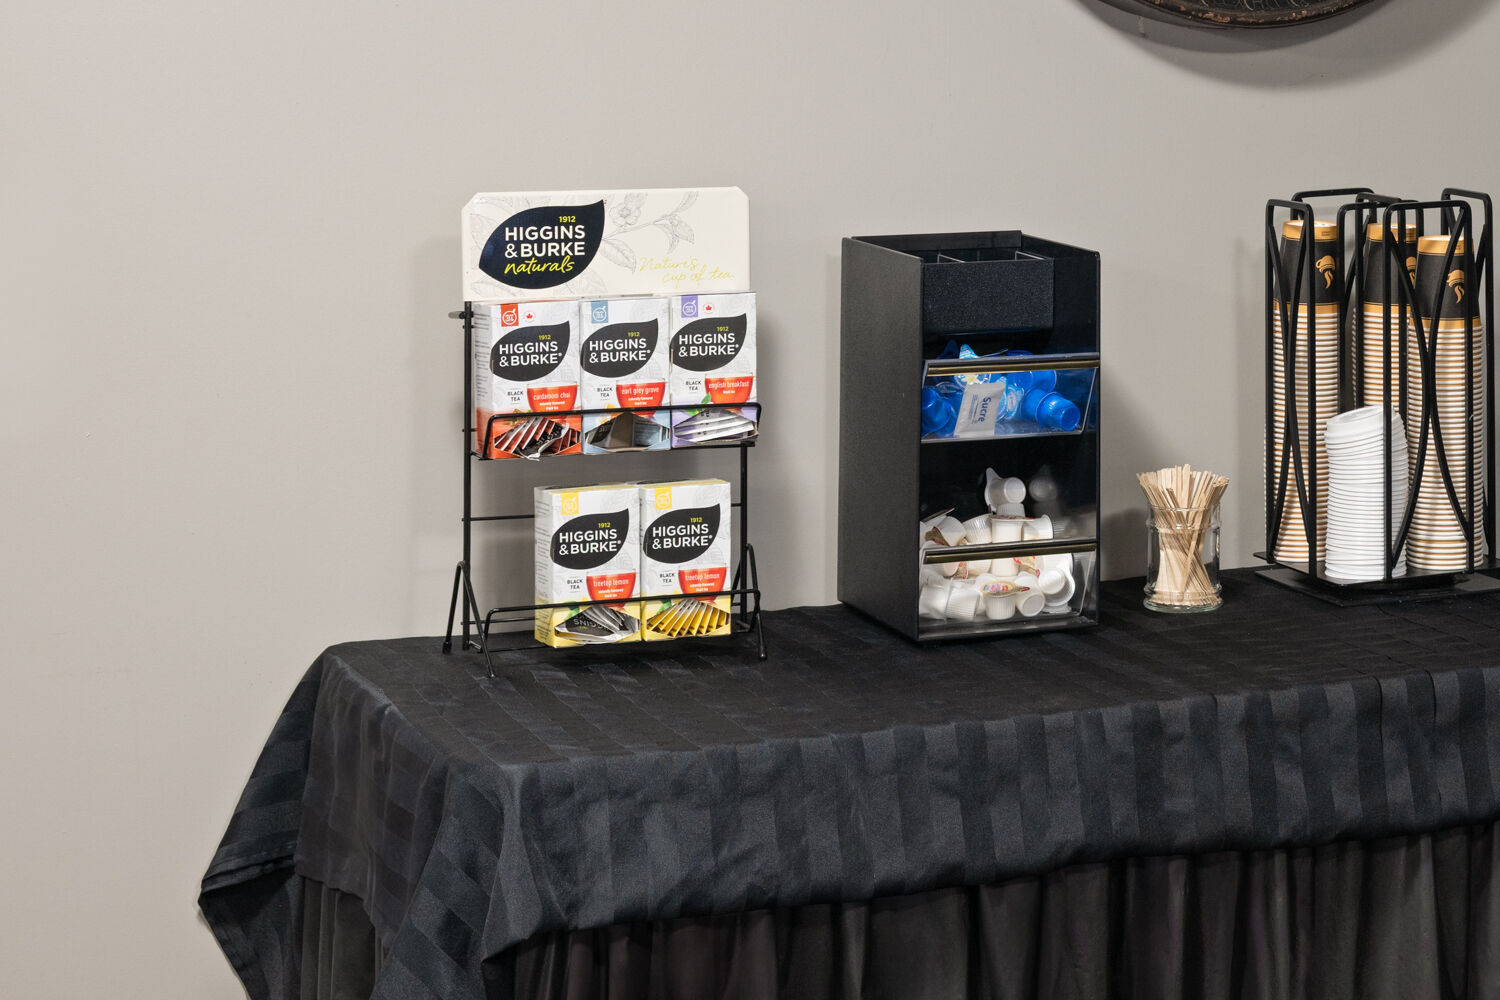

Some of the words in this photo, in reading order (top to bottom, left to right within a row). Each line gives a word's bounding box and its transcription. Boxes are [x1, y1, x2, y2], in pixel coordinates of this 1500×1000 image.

[505, 225, 586, 241] HIGGINS
[504, 243, 518, 259] &
[520, 241, 586, 258] BURKE
[504, 255, 575, 275] naturals
[662, 272, 687, 288] cup
[690, 263, 707, 285] of
[589, 338, 647, 351] HIGGINS
[679, 333, 735, 345] HIGGINS
[499, 341, 558, 355] HIGGINS
[678, 346, 688, 357] &
[499, 356, 509, 367] &
[589, 352, 599, 364] &
[709, 382, 726, 390] english
[978, 397, 992, 422] Sucre
[559, 529, 617, 543] HIGGINS
[652, 524, 709, 537] HIGGINS
[559, 544, 569, 556] &
[652, 538, 662, 550] &
